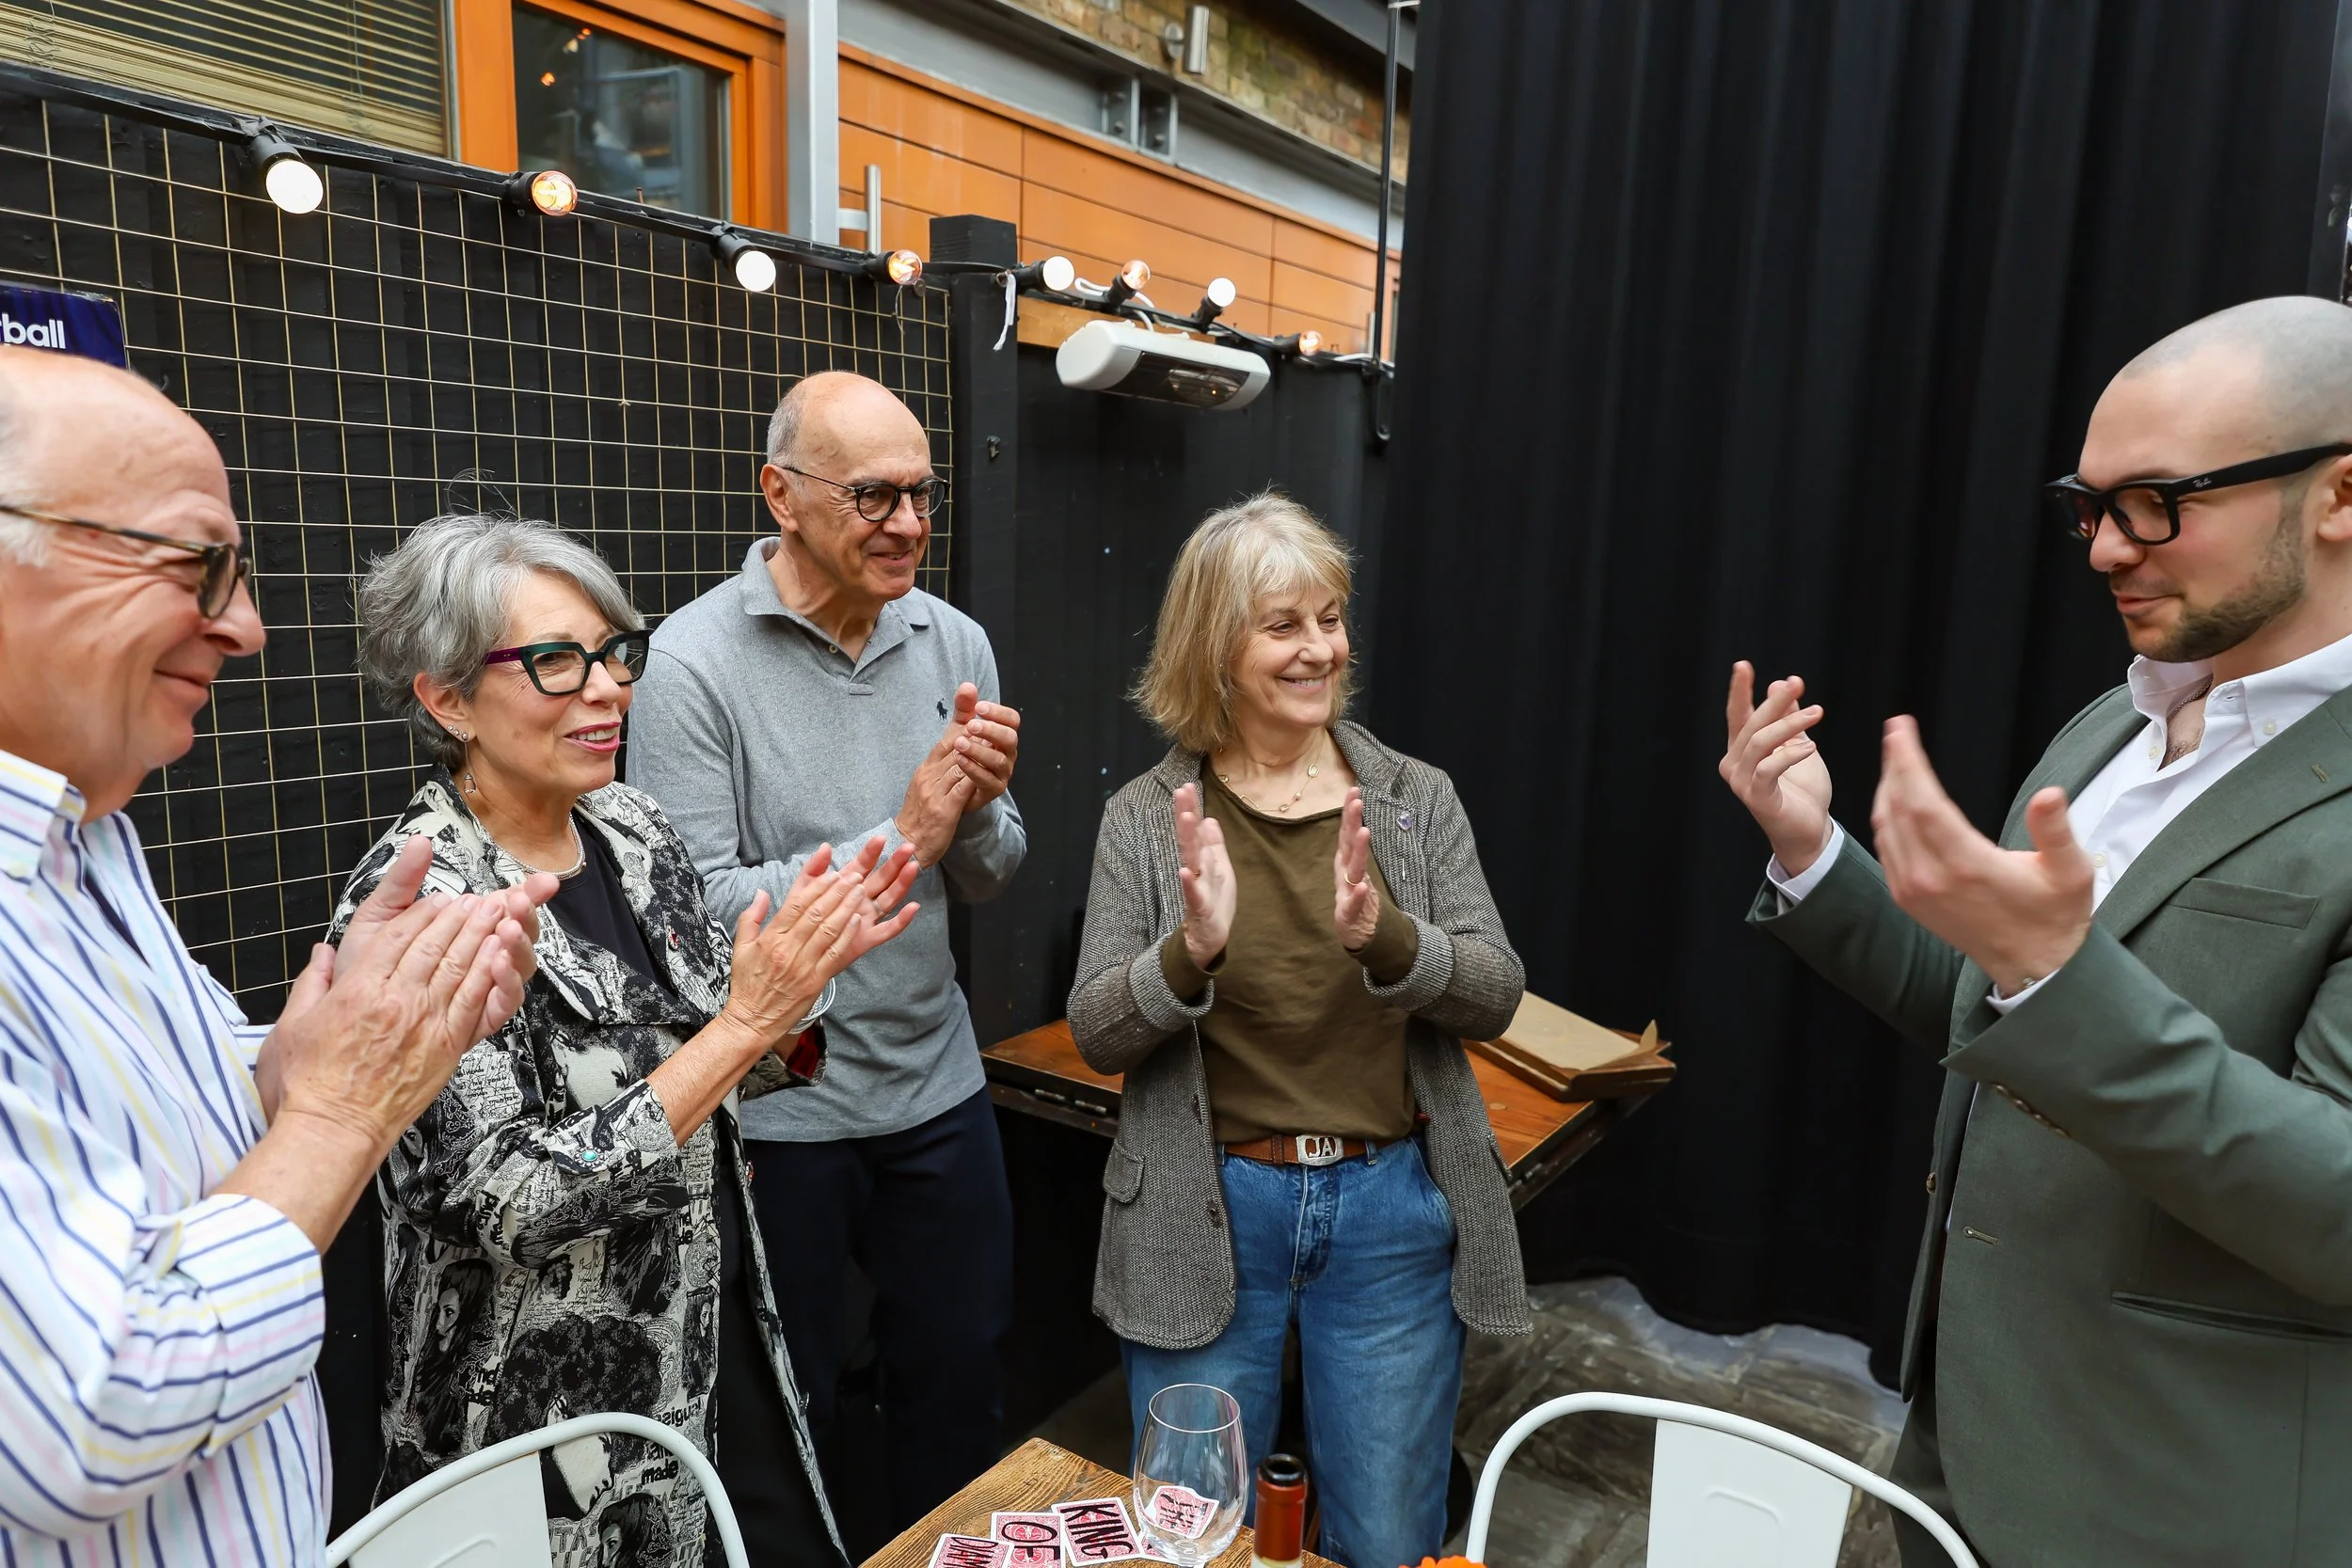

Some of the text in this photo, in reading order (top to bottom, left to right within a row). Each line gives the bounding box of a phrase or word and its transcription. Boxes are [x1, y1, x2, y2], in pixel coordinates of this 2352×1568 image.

[0, 313, 66, 349] ball
[1309, 1136, 1335, 1157] JA
[655, 1398, 701, 1427] sigual
[641, 1458, 679, 1485] made
[1001, 1521, 1060, 1560] OF
[1059, 1503, 1134, 1560] KING
[943, 1536, 999, 1568] DIAM
